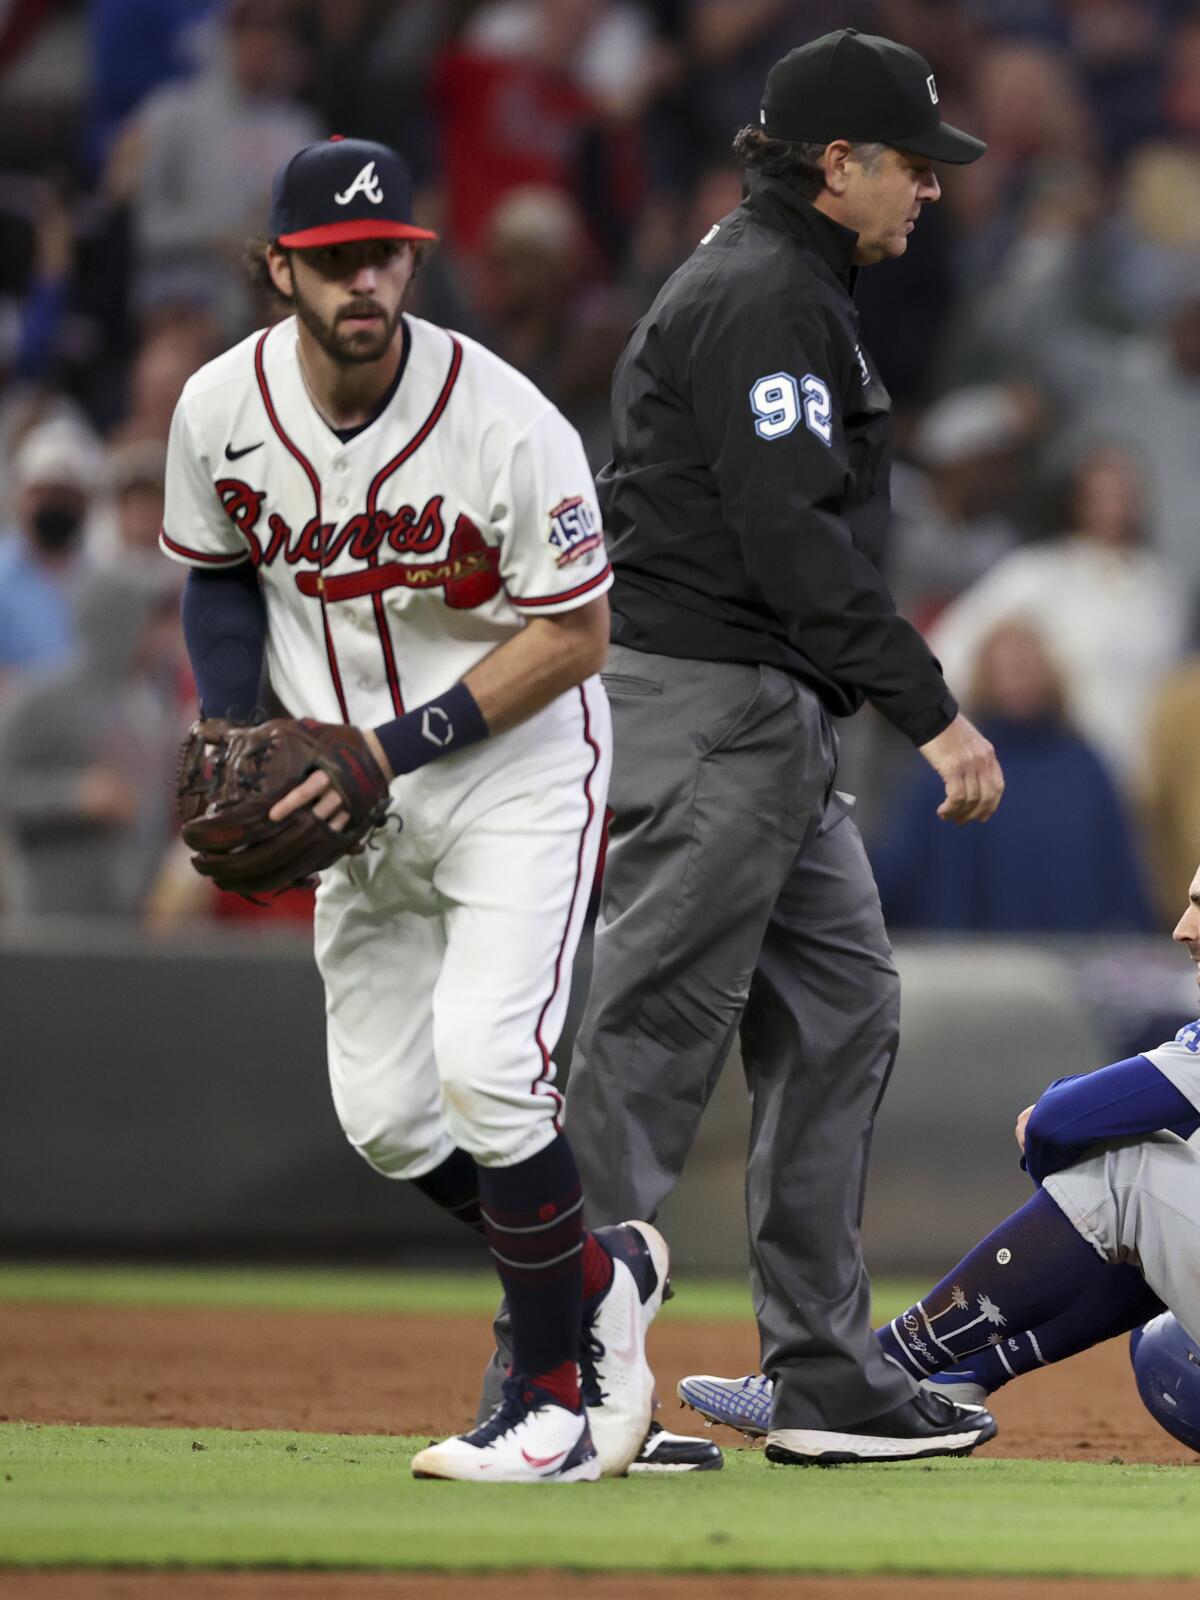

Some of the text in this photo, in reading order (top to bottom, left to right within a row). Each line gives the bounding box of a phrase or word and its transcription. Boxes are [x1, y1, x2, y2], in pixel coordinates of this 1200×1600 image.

[334, 160, 384, 205] A
[749, 371, 832, 447] 92
[214, 479, 444, 568] Braves
